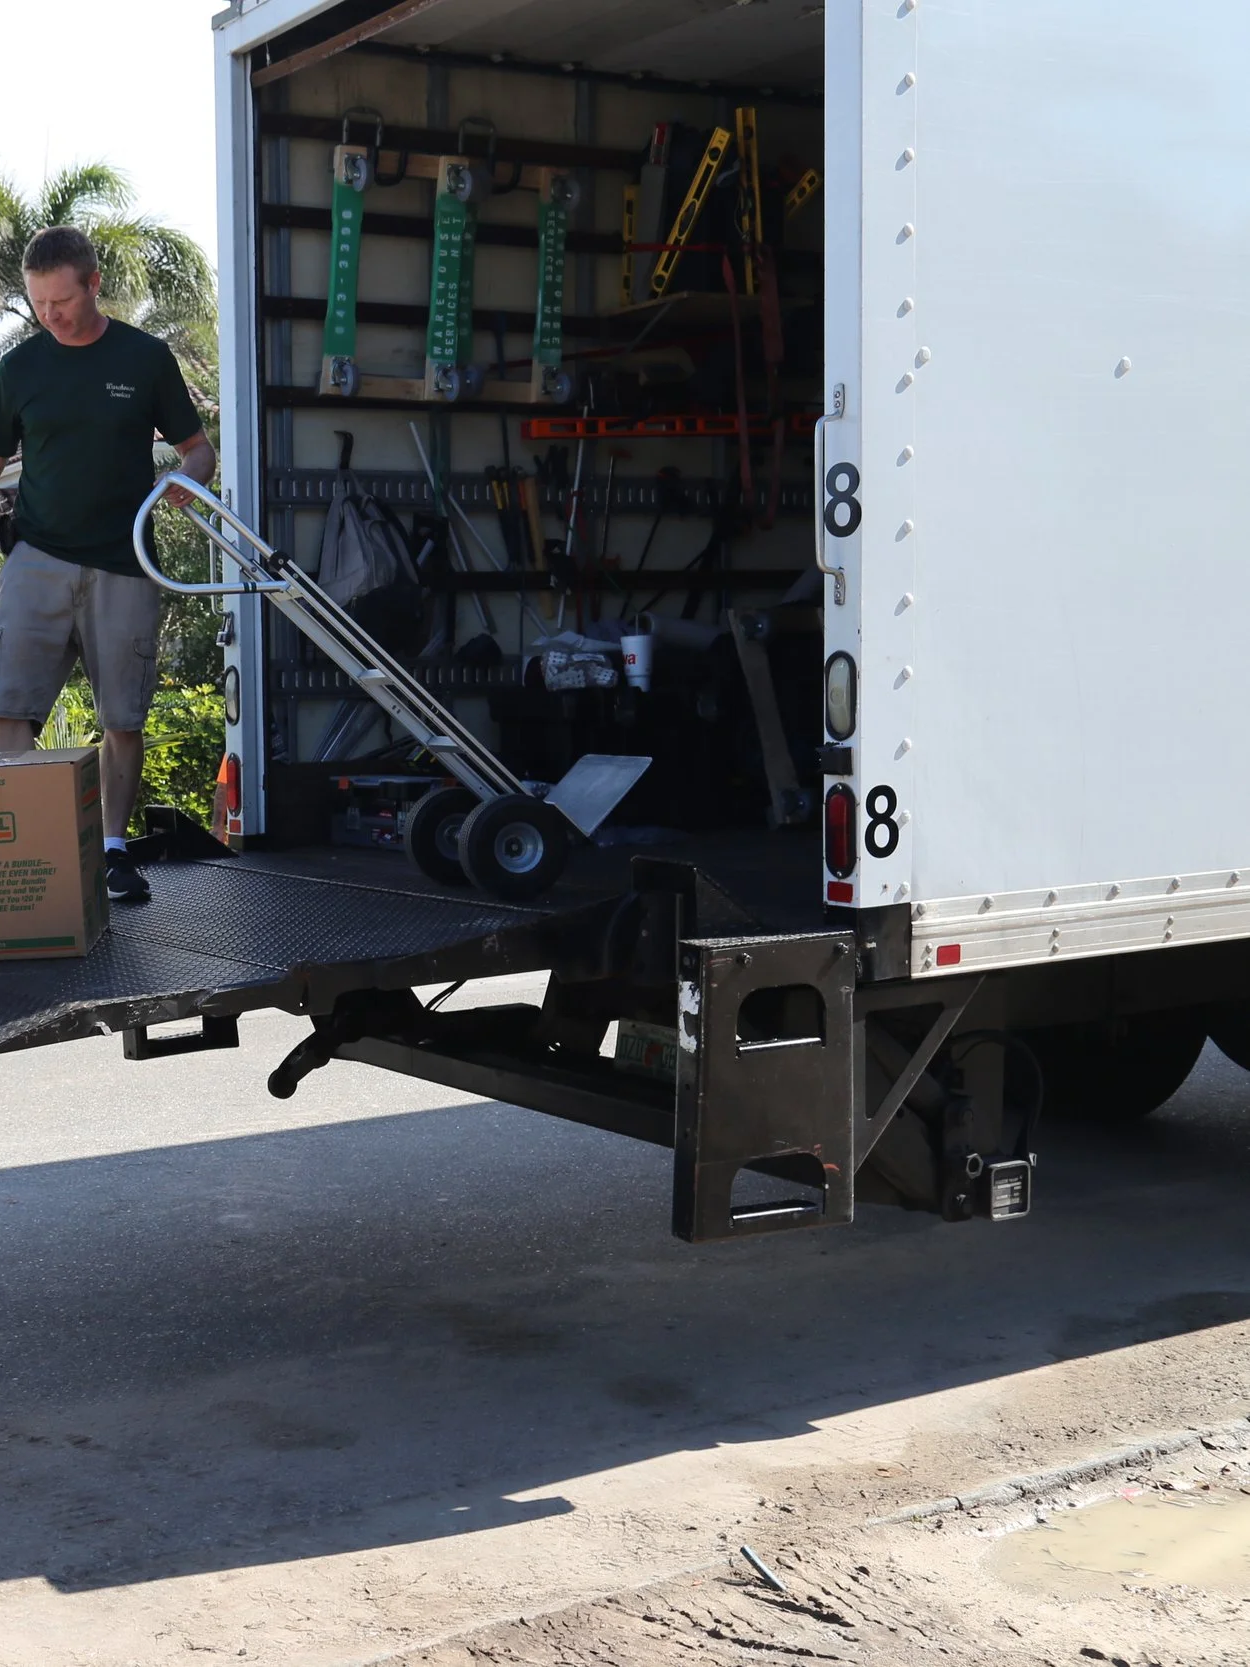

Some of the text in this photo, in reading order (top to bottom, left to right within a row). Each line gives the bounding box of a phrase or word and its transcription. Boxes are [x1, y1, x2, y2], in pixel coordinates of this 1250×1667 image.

[432, 215, 451, 357] WAREHOUSE
[824, 462, 862, 538] 8
[864, 784, 899, 859] 8
